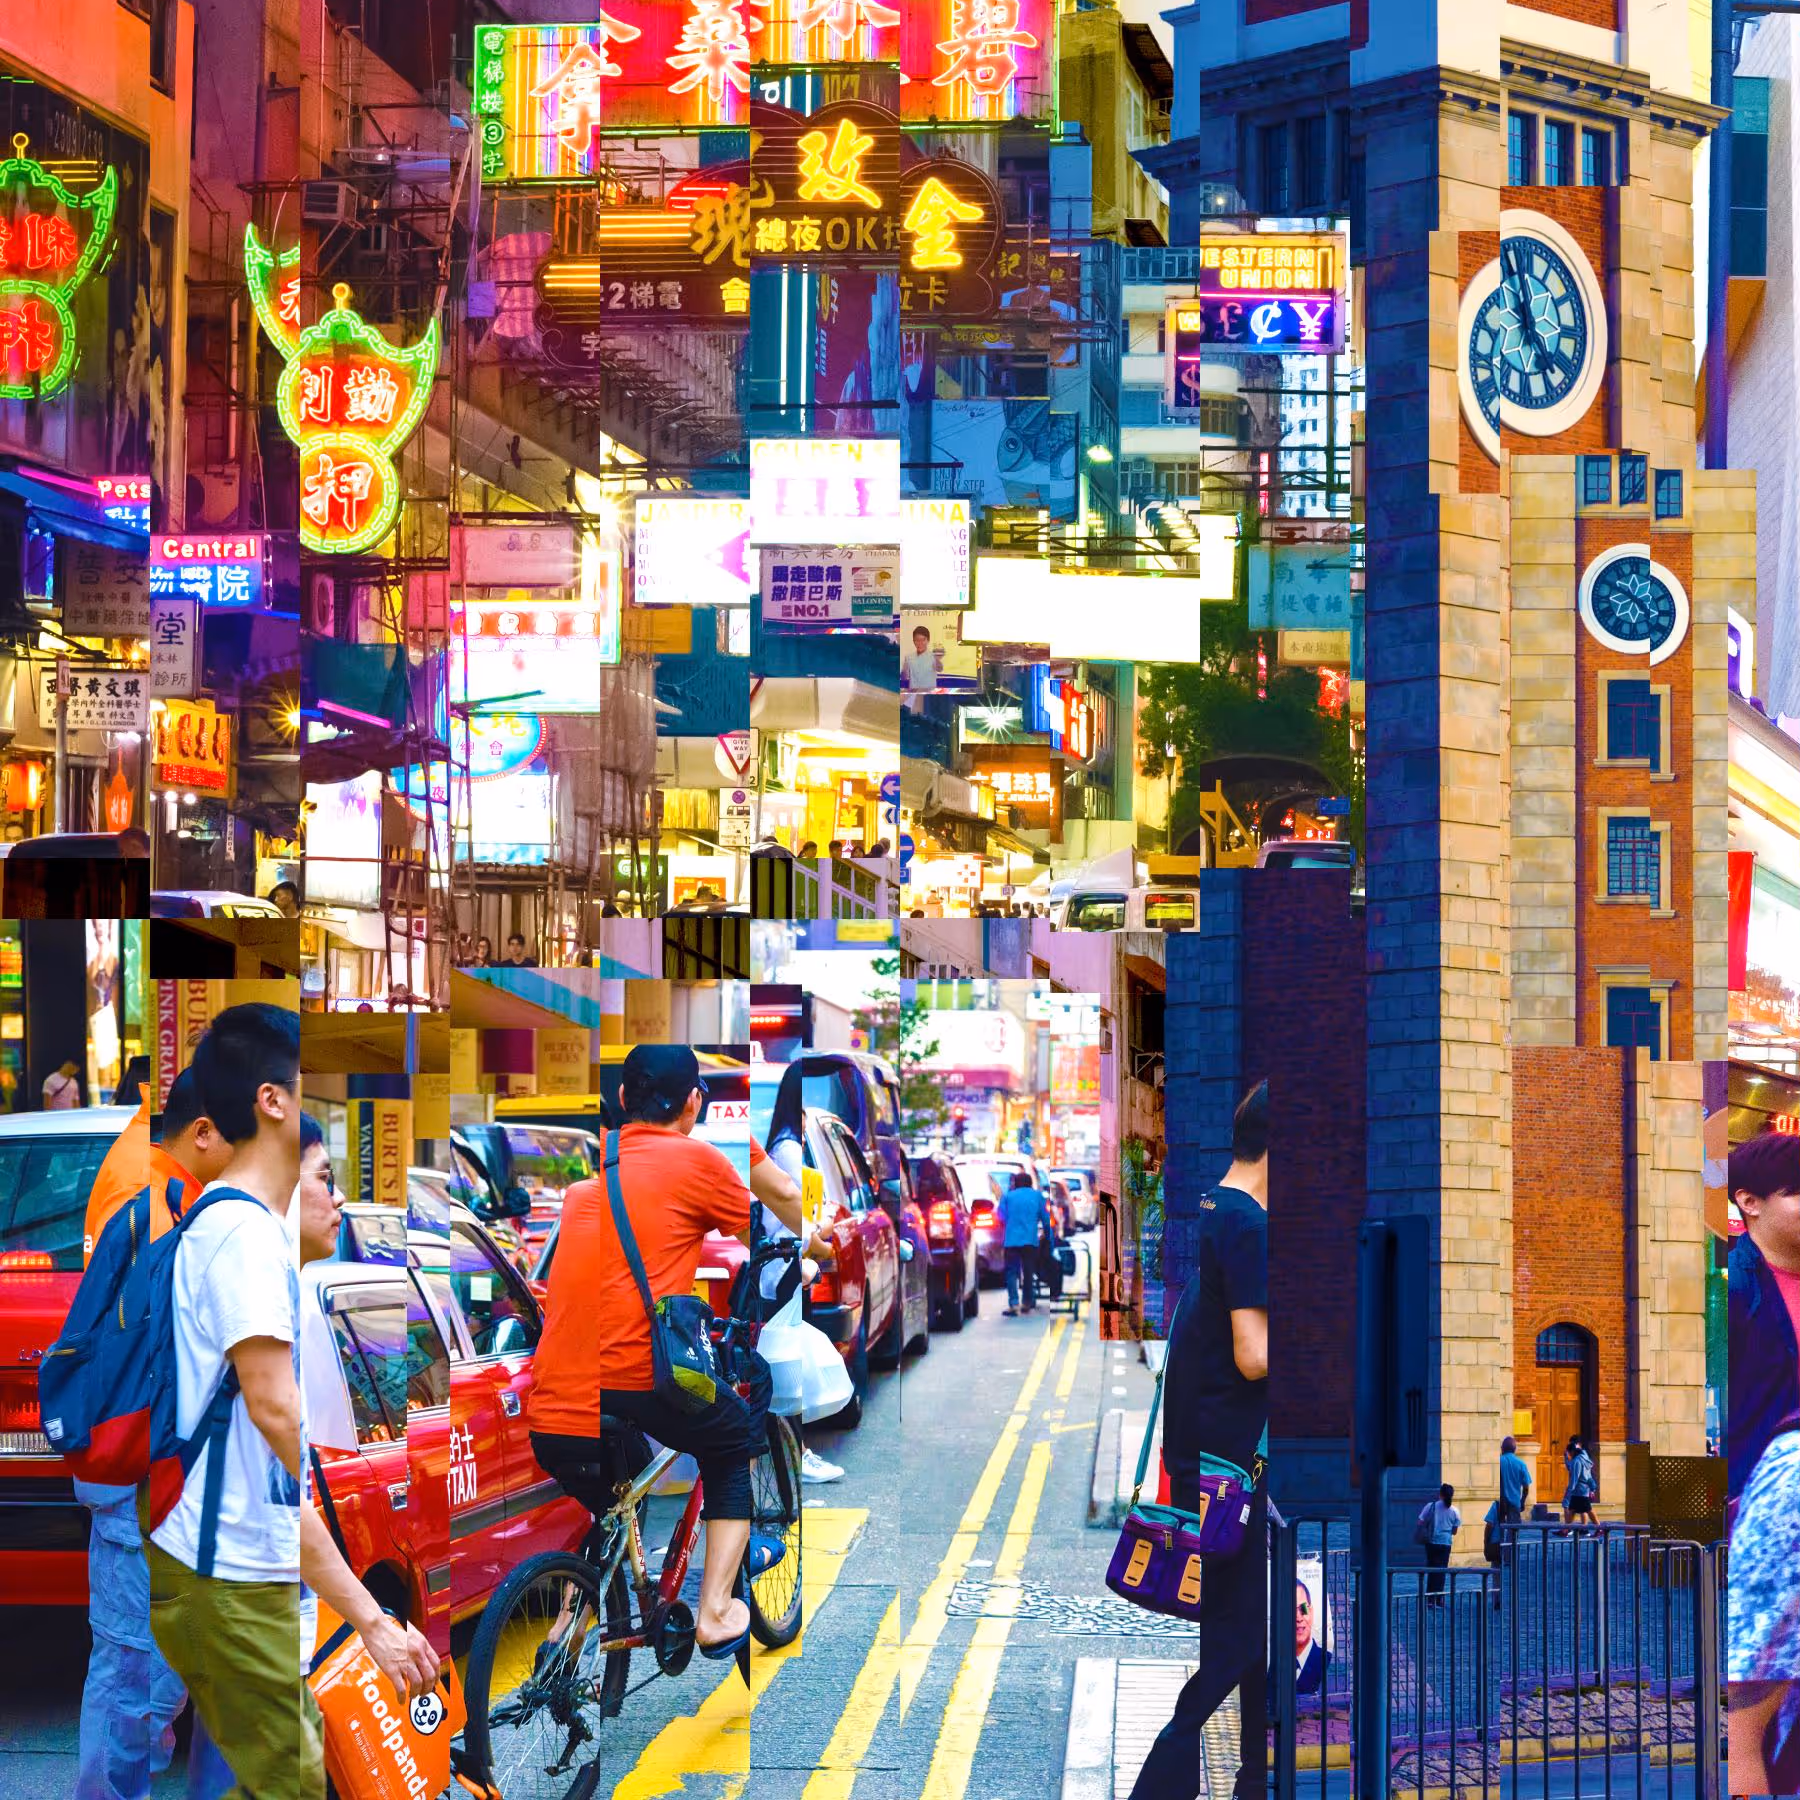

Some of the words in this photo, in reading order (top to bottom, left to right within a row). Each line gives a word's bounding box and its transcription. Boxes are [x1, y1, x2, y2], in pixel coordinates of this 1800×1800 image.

[1220, 269, 1314, 288] UNION
[934, 469, 962, 479] ENJY
[98, 480, 150, 499] Pets
[163, 538, 255, 558] Central
[771, 585, 842, 602] 撒隆巴斯
[156, 612, 186, 646] 堂
